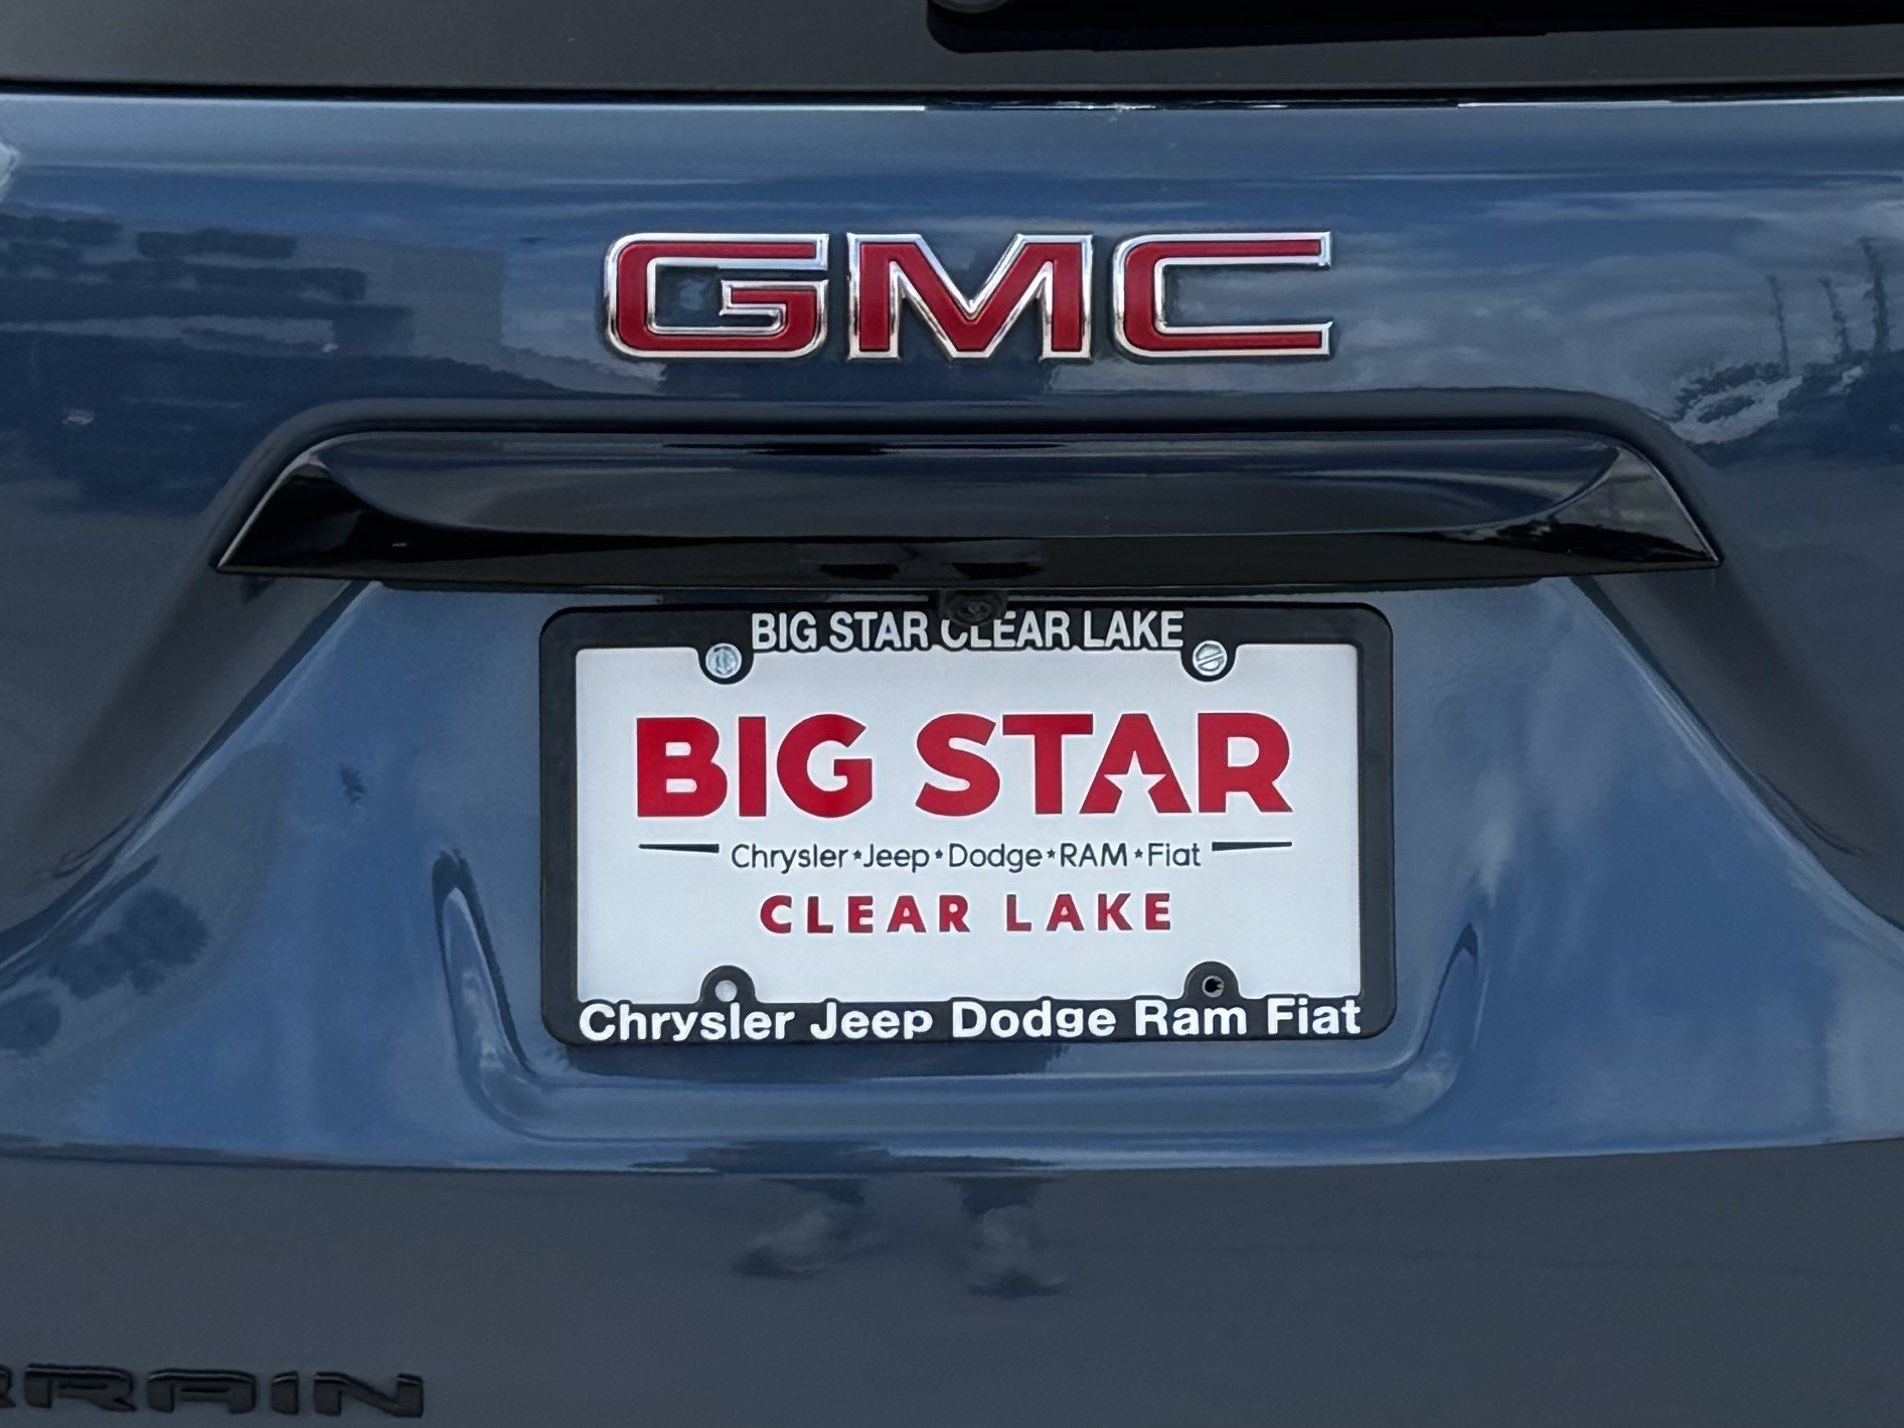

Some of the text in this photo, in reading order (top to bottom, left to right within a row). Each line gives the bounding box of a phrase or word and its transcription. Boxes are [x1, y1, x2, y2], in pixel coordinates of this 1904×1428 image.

[603, 232, 1334, 360] GMC
[751, 610, 818, 650] BIG
[828, 610, 930, 650] STAR
[1083, 609, 1185, 648] LAKE
[636, 712, 1291, 818] BIG STAR
[731, 841, 1202, 875] Chrysler Jeep Dodge RAM Fiat
[760, 893, 1171, 933] CLEAR LAKE
[578, 997, 1362, 1042] Chrysler Jeep Dodge Ram Fiat
